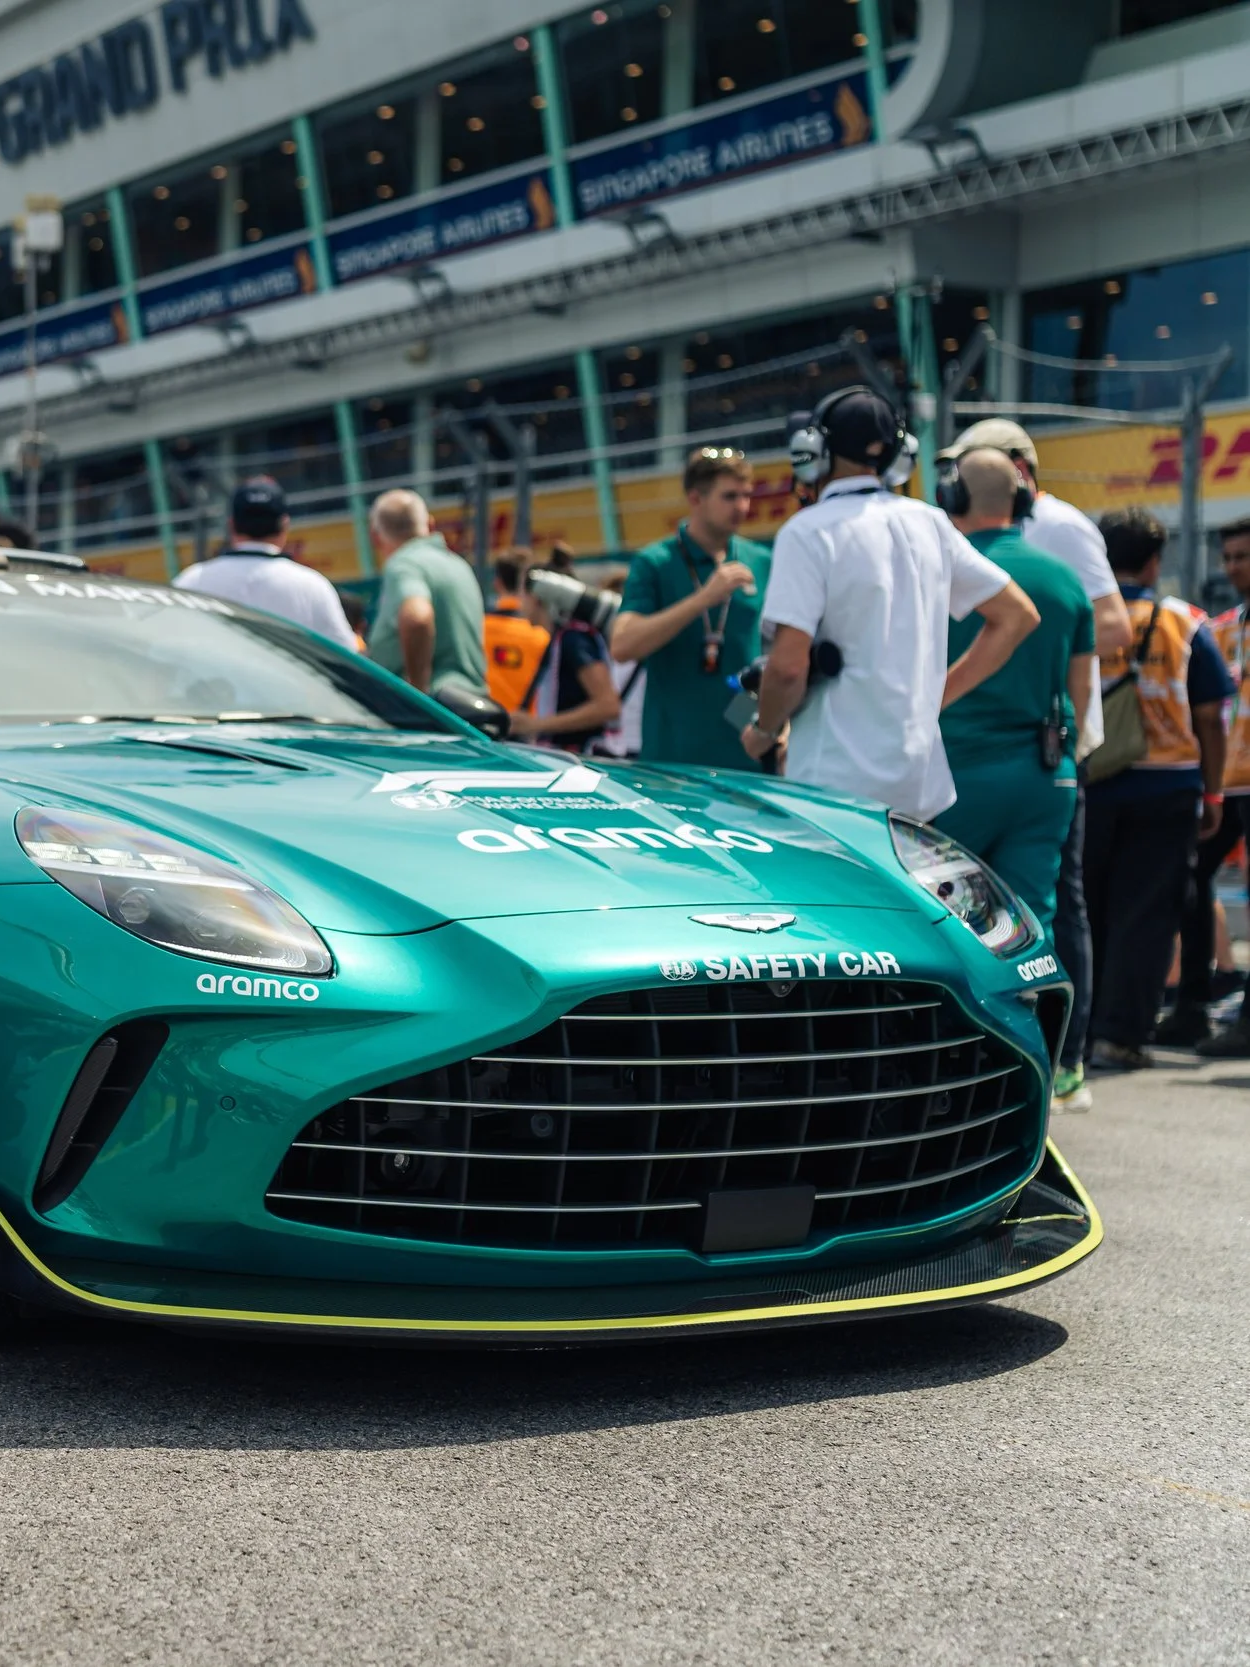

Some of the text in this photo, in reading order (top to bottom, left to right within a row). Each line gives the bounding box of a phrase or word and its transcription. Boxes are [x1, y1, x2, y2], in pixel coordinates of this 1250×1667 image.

[578, 110, 834, 210] SINGAPORE AIRLINES
[456, 823, 774, 854] aramco
[704, 953, 826, 981] SAFETY
[837, 951, 902, 976] CAR
[196, 973, 320, 1001] aramco
